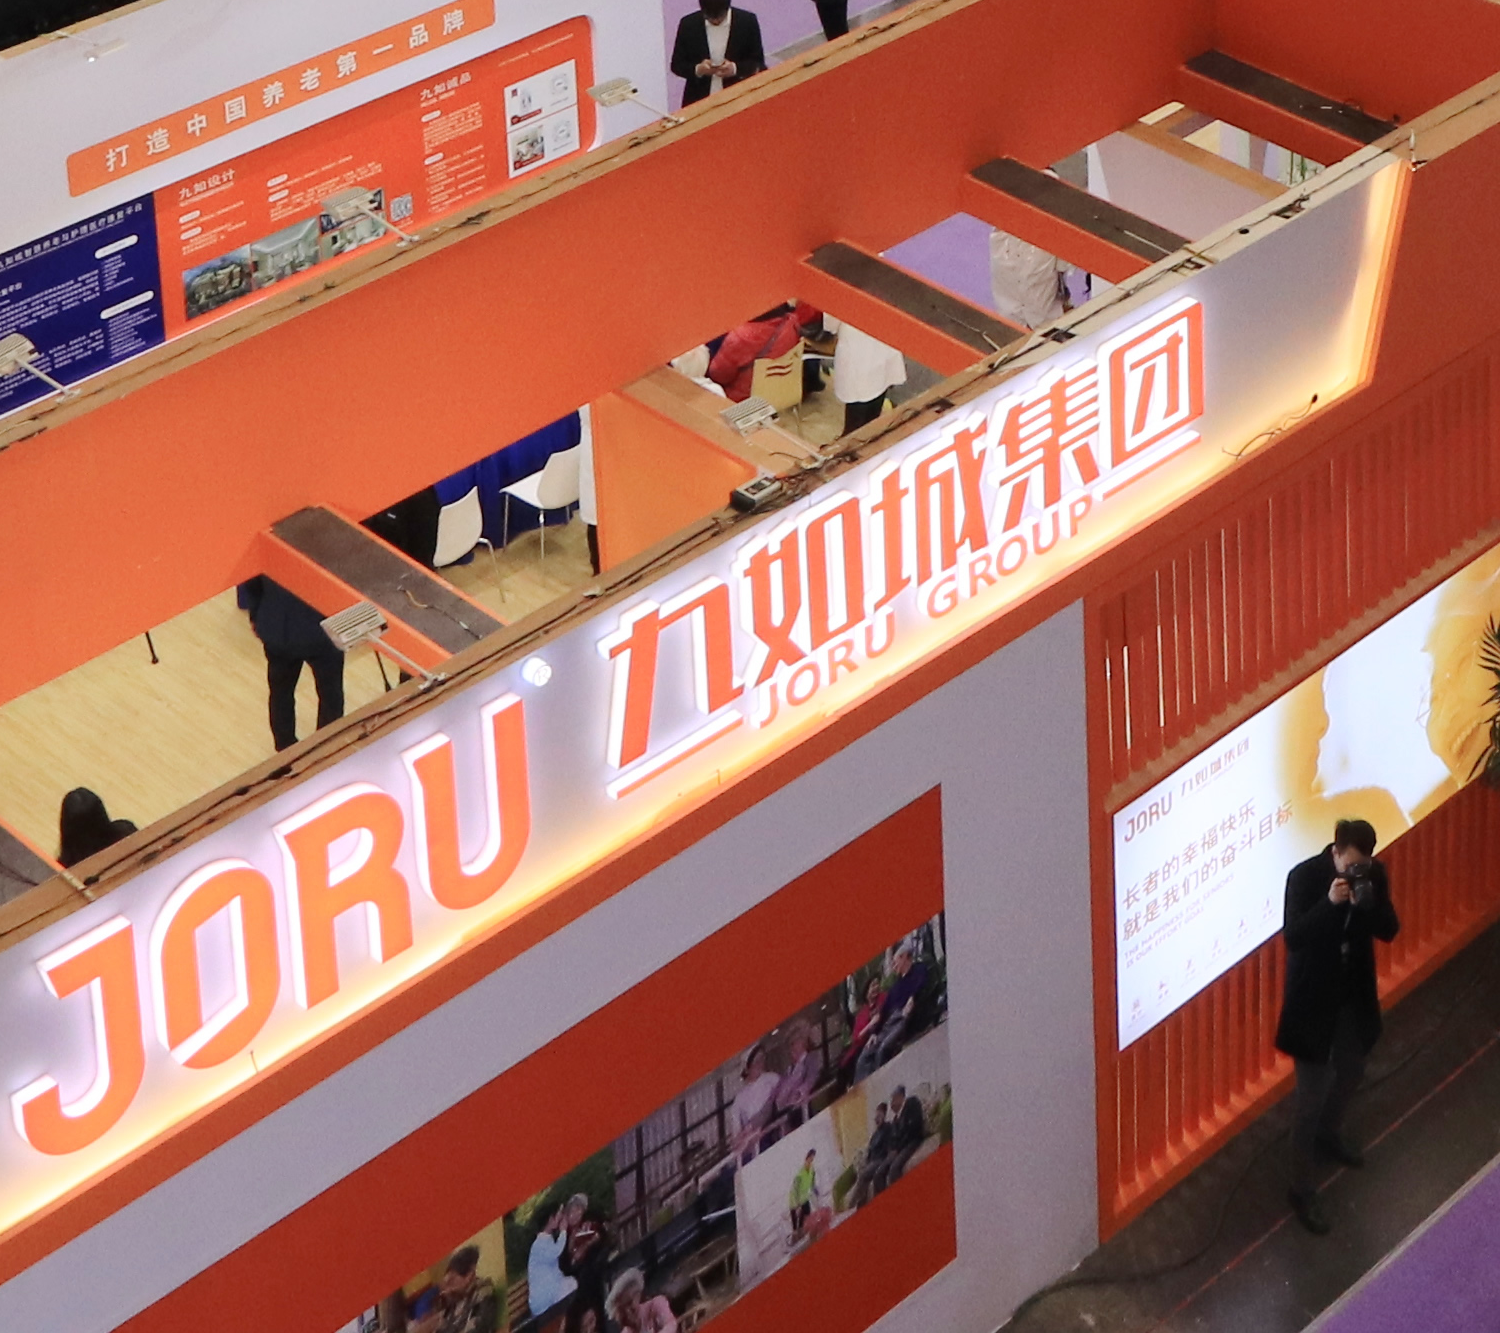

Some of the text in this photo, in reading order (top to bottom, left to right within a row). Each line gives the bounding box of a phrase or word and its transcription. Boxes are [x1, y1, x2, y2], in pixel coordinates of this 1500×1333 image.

[104, 5, 467, 175] 打造中国养老第一品牌
[177, 166, 236, 201] 九如设计
[754, 493, 1097, 731] JORU GROUP
[12, 295, 1206, 1157] JORU 九如城集团
[1120, 795, 1258, 913] 长者的幸福快乐
[1121, 800, 1295, 943] 就是我们的奋斗目标
[1123, 790, 1174, 844] JORU
